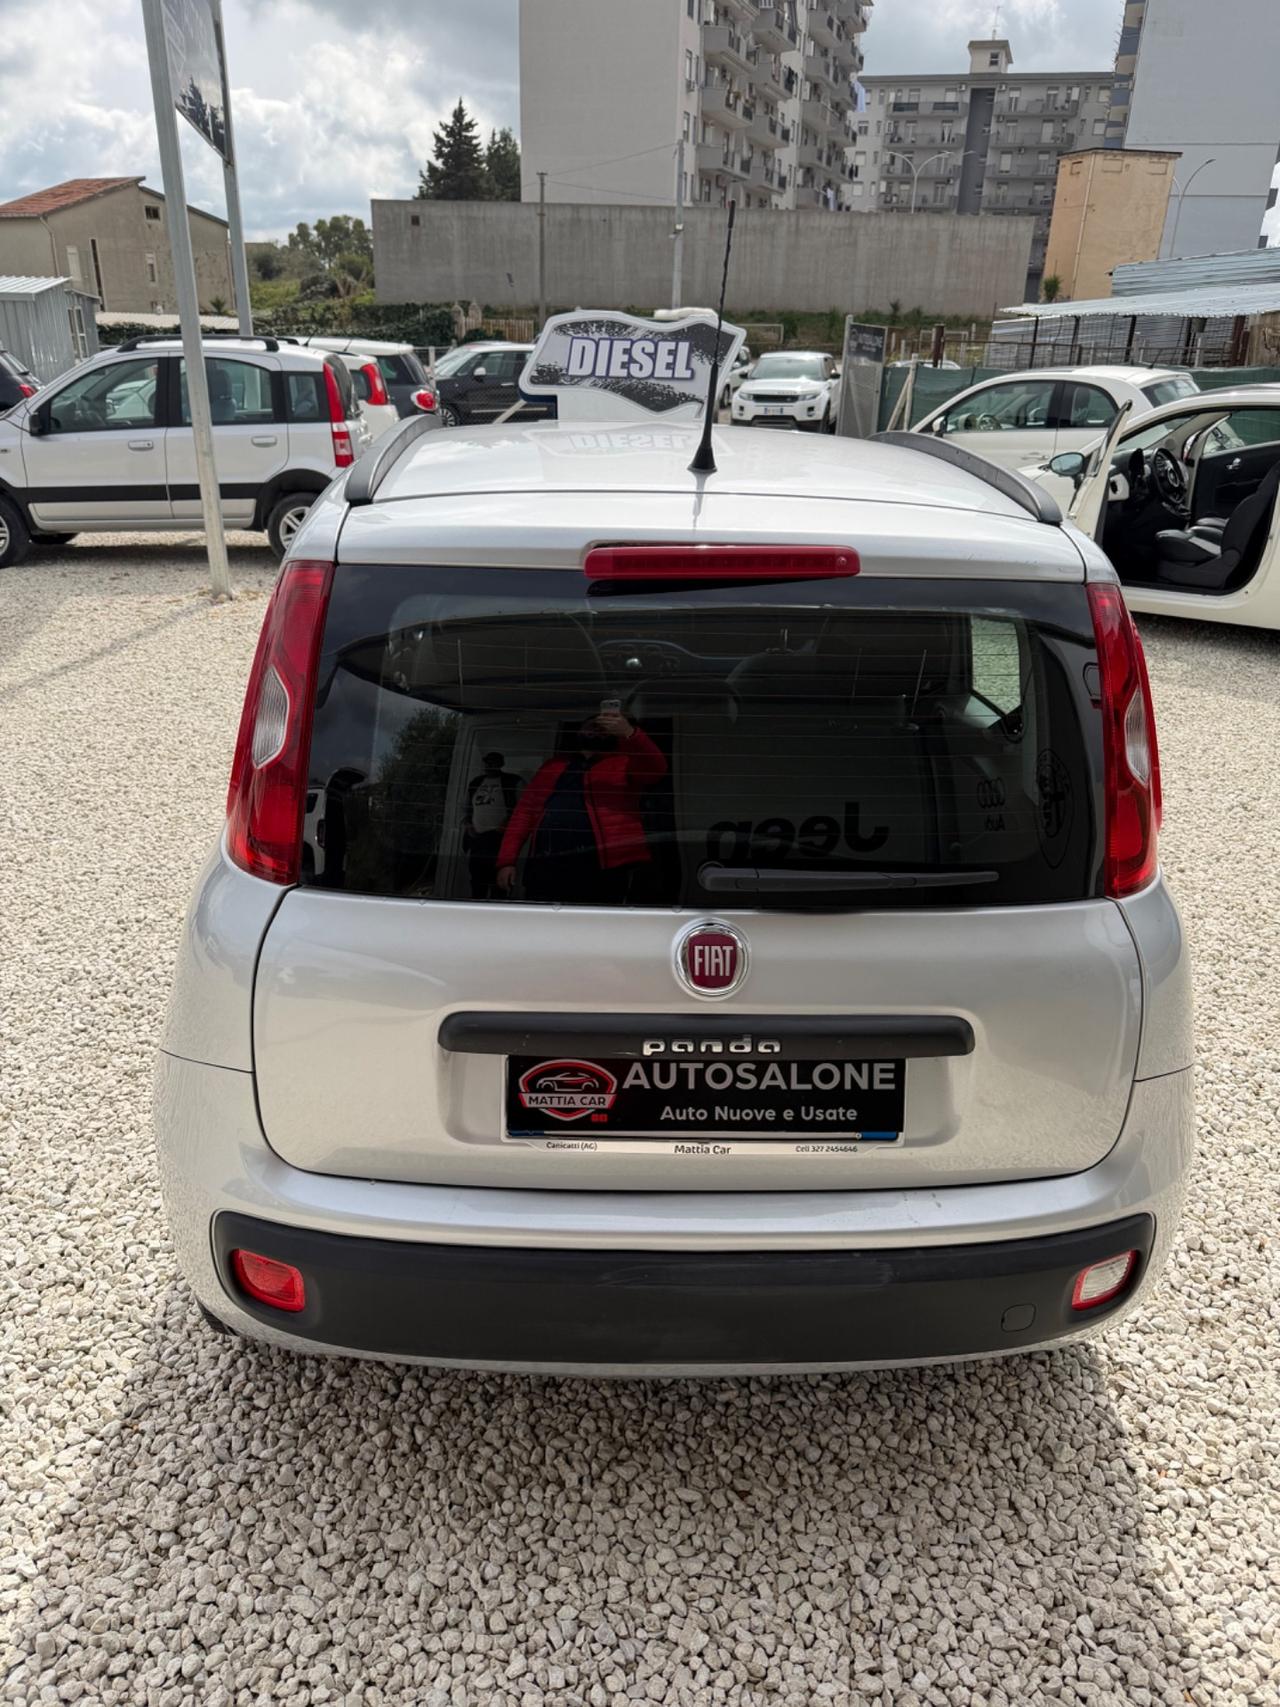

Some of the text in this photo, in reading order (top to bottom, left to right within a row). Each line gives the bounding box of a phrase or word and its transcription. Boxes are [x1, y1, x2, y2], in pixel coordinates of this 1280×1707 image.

[567, 336, 695, 380] DIESEL
[694, 945, 734, 977] FIAT
[642, 1035, 781, 1056] panda
[622, 1062, 896, 1090] AUTOSALONE
[528, 1095, 606, 1106] MATTIA CAR
[660, 1105, 858, 1121] Auto Nuove e Usate
[580, 1141, 598, 1151] (AG)
[674, 1144, 732, 1155] Mattia Car
[795, 1145, 810, 1153] Cell
[811, 1145, 825, 1153] 327
